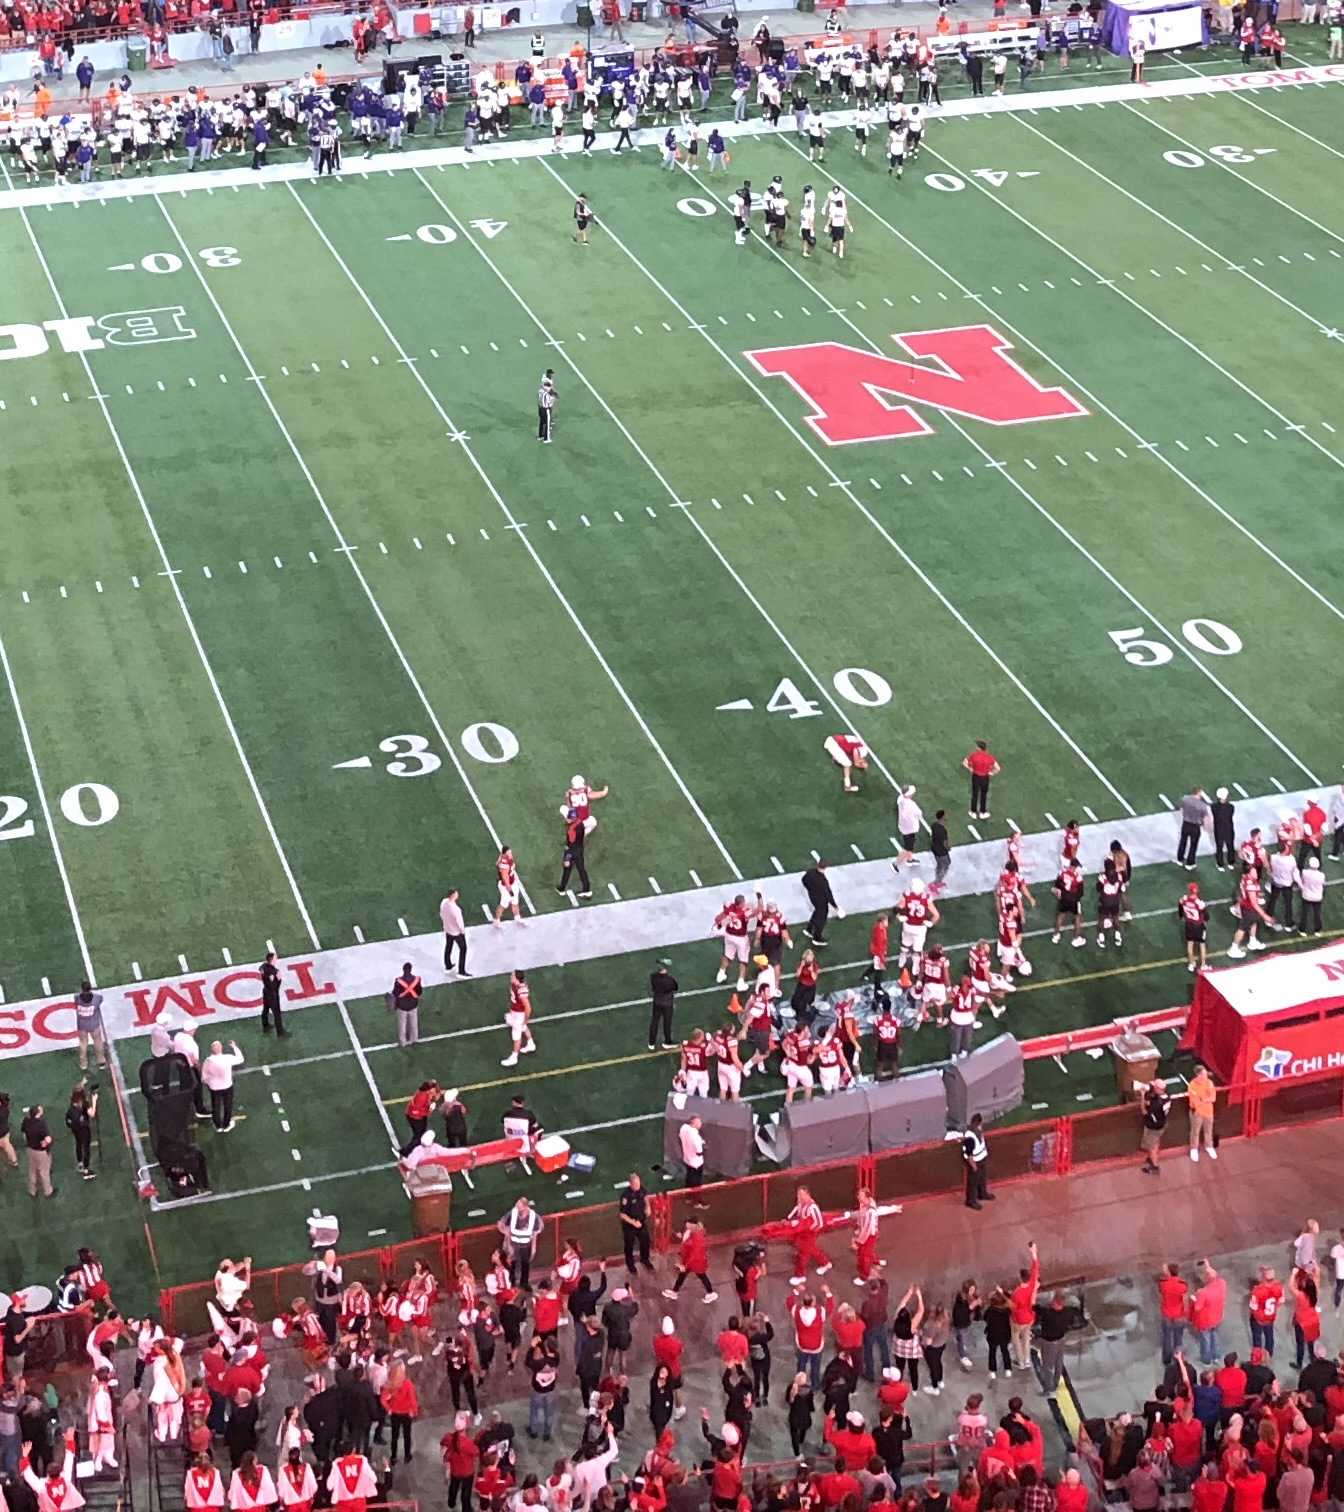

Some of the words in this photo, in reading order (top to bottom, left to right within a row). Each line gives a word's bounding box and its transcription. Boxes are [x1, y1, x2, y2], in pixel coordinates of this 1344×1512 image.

[1211, 67, 1311, 90] TOM
[1162, 144, 1257, 169] 30
[924, 168, 1009, 193] 40
[416, 218, 508, 244] 40
[141, 246, 242, 274] 30
[742, 323, 1093, 447] N
[1108, 618, 1243, 667] 50
[766, 668, 893, 720] 40
[378, 721, 520, 779] 30
[907, 902, 925, 918] 73
[128, 960, 337, 1028] TOM
[879, 1026, 897, 1039] 30
[1291, 1054, 1327, 1076] CHI
[196, 1474, 209, 1489] N
[346, 1464, 359, 1479] N
[50, 1484, 63, 1498] N
